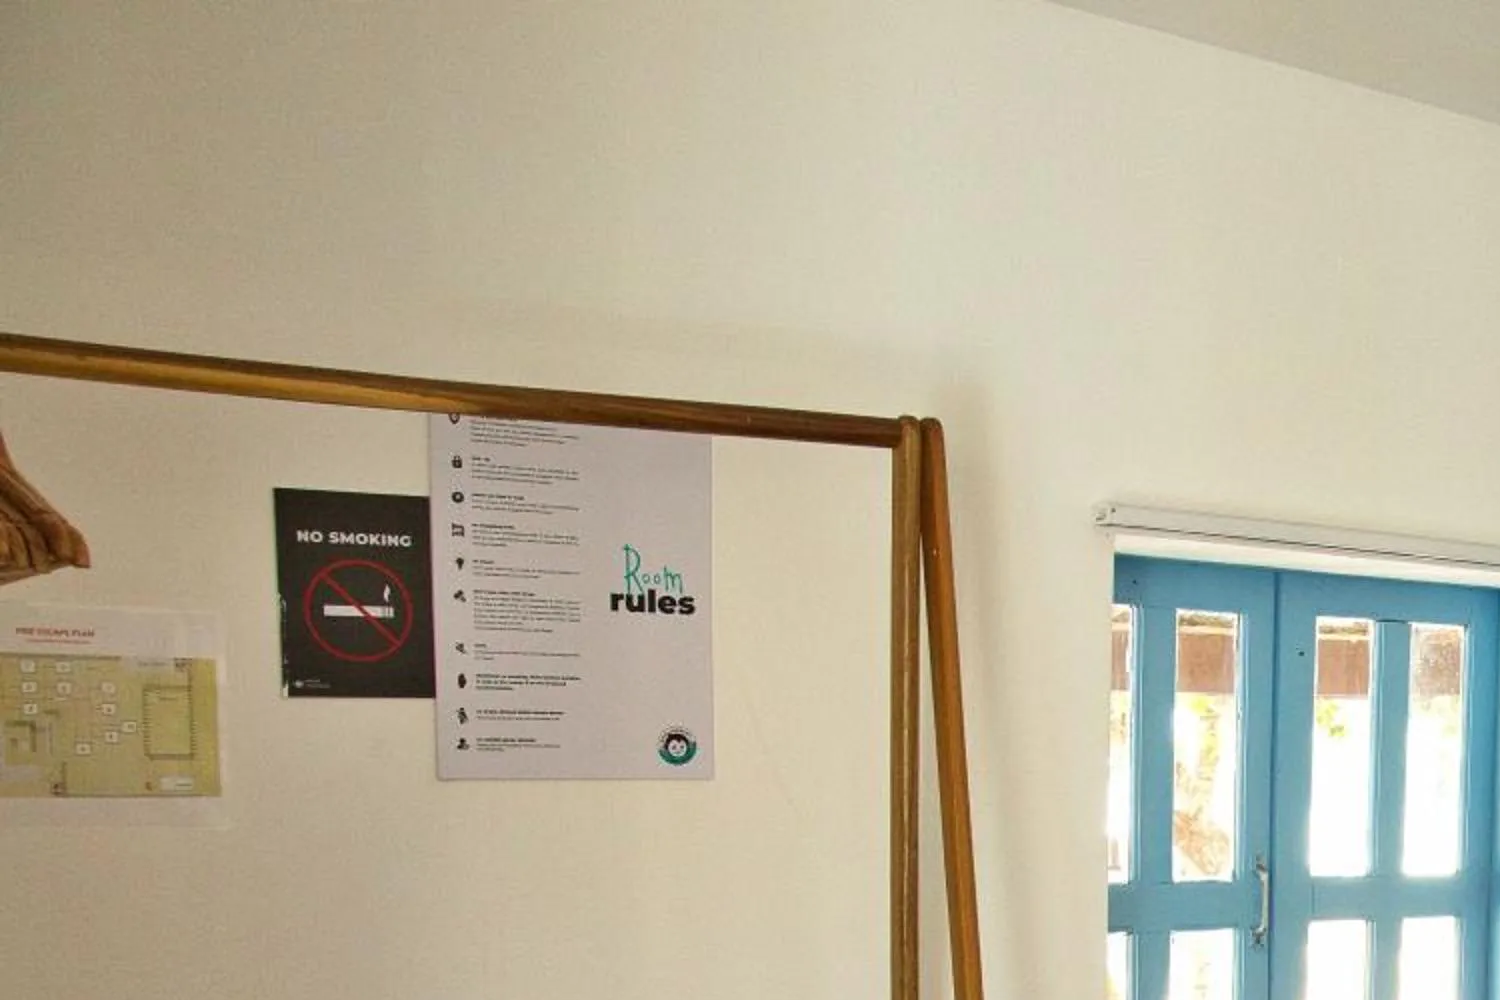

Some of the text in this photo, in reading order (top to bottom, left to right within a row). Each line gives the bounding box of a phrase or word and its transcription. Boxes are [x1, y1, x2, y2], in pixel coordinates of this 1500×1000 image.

[296, 529, 413, 547] NO SMOKING
[622, 543, 683, 593] Room
[610, 589, 696, 615] rules
